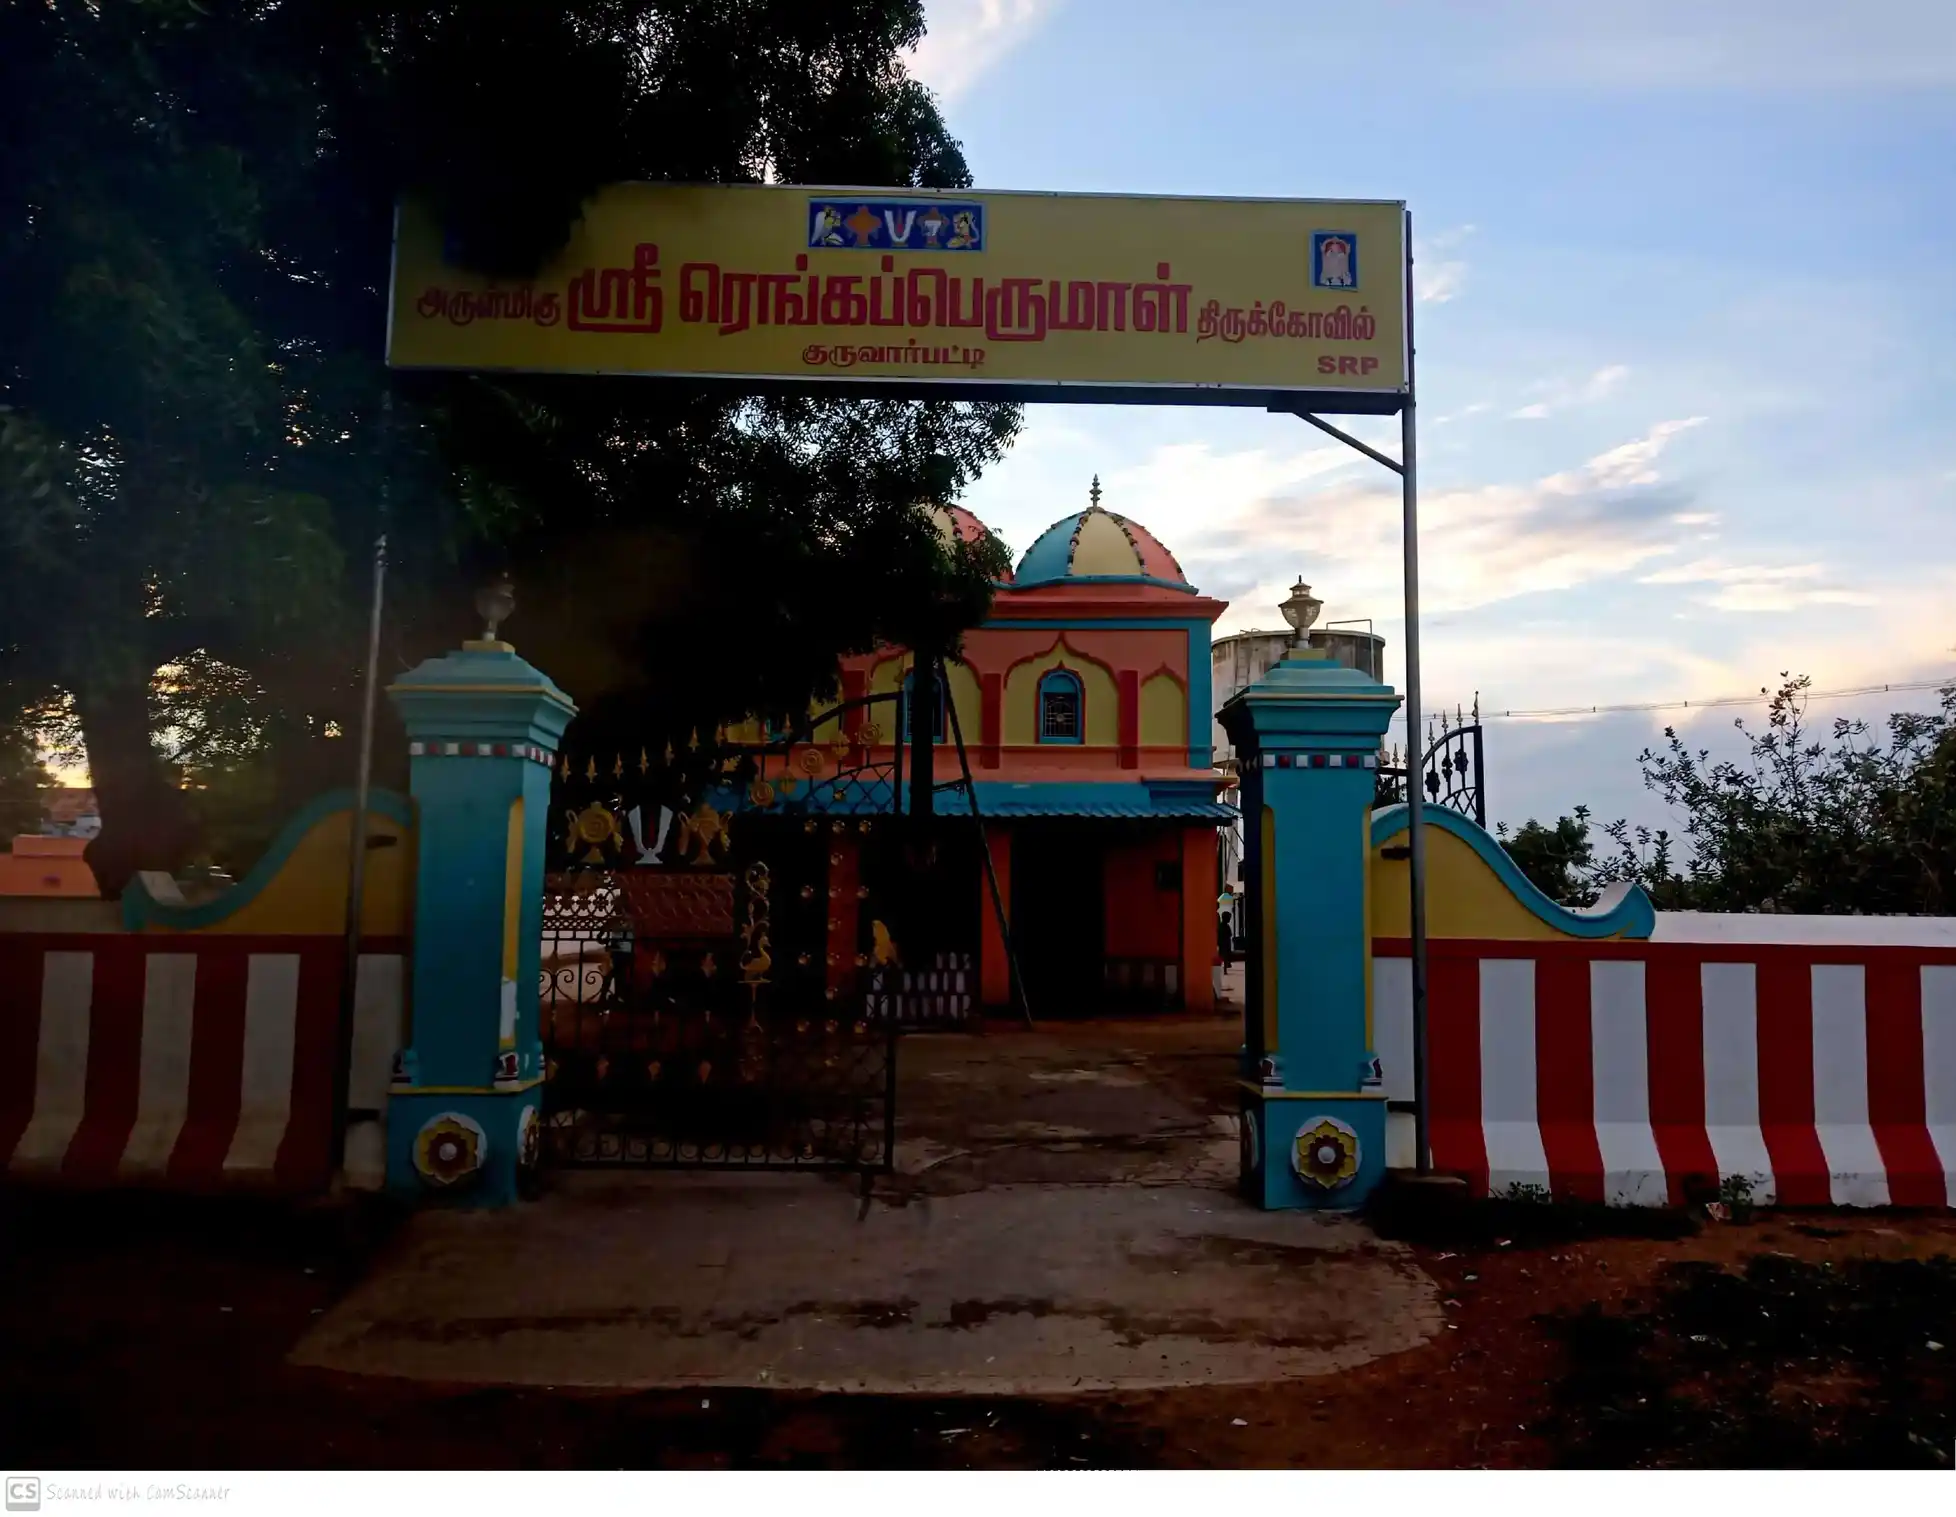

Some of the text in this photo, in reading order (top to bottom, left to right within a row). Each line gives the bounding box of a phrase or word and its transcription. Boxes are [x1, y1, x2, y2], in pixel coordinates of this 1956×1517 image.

[680, 254, 1193, 341] ரெங்கப்பெருமாள்
[1197, 300, 1375, 343] திருக்கோவில்
[803, 339, 985, 369] குருவார்பட்டி
[1317, 355, 1379, 375] SRP
